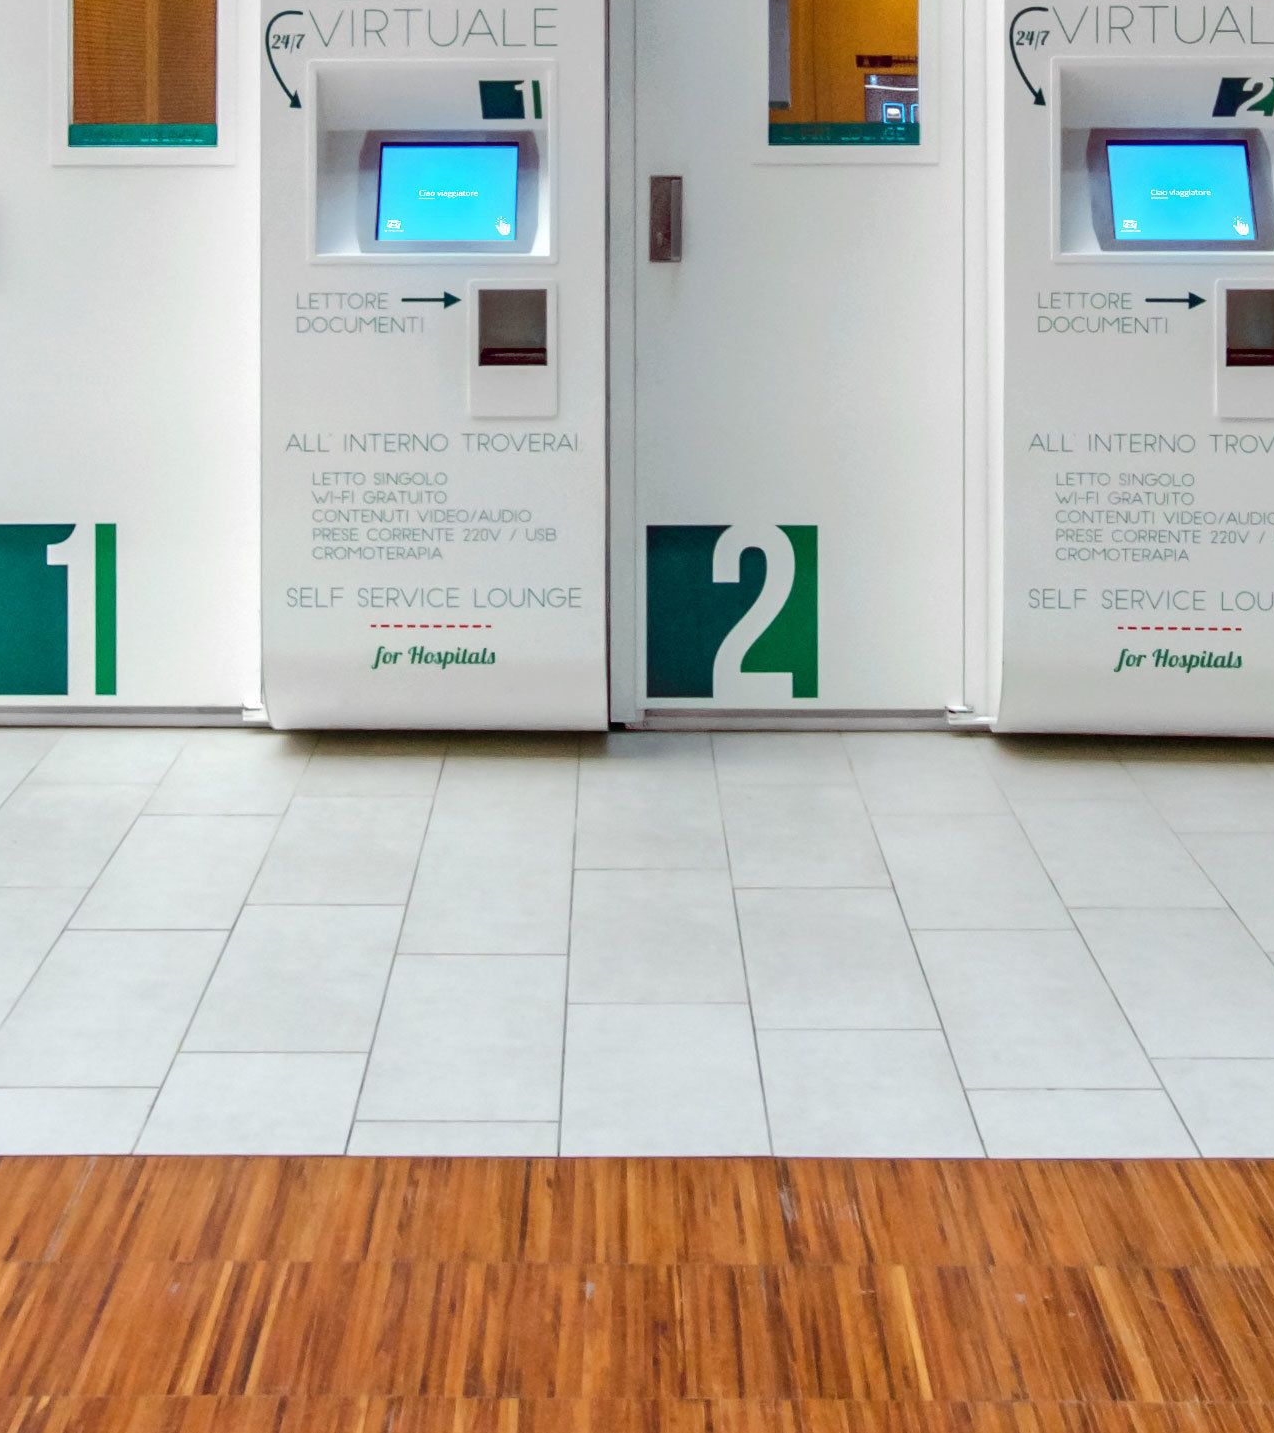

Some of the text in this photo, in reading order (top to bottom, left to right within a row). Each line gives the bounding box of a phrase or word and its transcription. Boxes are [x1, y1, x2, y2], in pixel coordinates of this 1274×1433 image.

[308, 8, 559, 47] VIRTUALE
[271, 33, 306, 53] 24/7
[1015, 29, 1050, 49] 24/7
[296, 292, 389, 310] LETTORE
[1037, 292, 1133, 310] LETTORE
[296, 316, 424, 334] DOCUMENTI
[1037, 316, 1169, 334] DOCUMENTI
[343, 433, 449, 453] INTERNO
[1088, 433, 1196, 454] INTERNO
[312, 472, 448, 486] LETTO SINGOLO
[1055, 473, 1195, 487] LETTO SINGOLO
[312, 491, 448, 504] WI-FI GRATUITO
[1055, 492, 1195, 506] WI-FI GRATUITO
[312, 509, 532, 524] CONTENUTI VIDEO/AUDIO
[1055, 510, 1155, 525] CONTENUTI
[312, 528, 359, 542] PRESE
[367, 528, 455, 542] CORRENTE
[462, 528, 501, 542] 220V
[525, 528, 557, 542] USB
[1055, 529, 1103, 543] PRESE
[1111, 529, 1201, 544] CORRENTE
[1210, 530, 1249, 544] 220V
[312, 546, 443, 560] CROMOTERAPIA
[1055, 547, 1190, 562] CROMOTERAPIA
[286, 587, 582, 609] SELF SERVICE LOUNGE
[1028, 588, 1088, 610] SELF
[1101, 589, 1207, 612] SERVICE
[712, 524, 796, 698] 2
[371, 645, 496, 670] for Hospitals
[1114, 648, 1243, 673] for Hospitals
